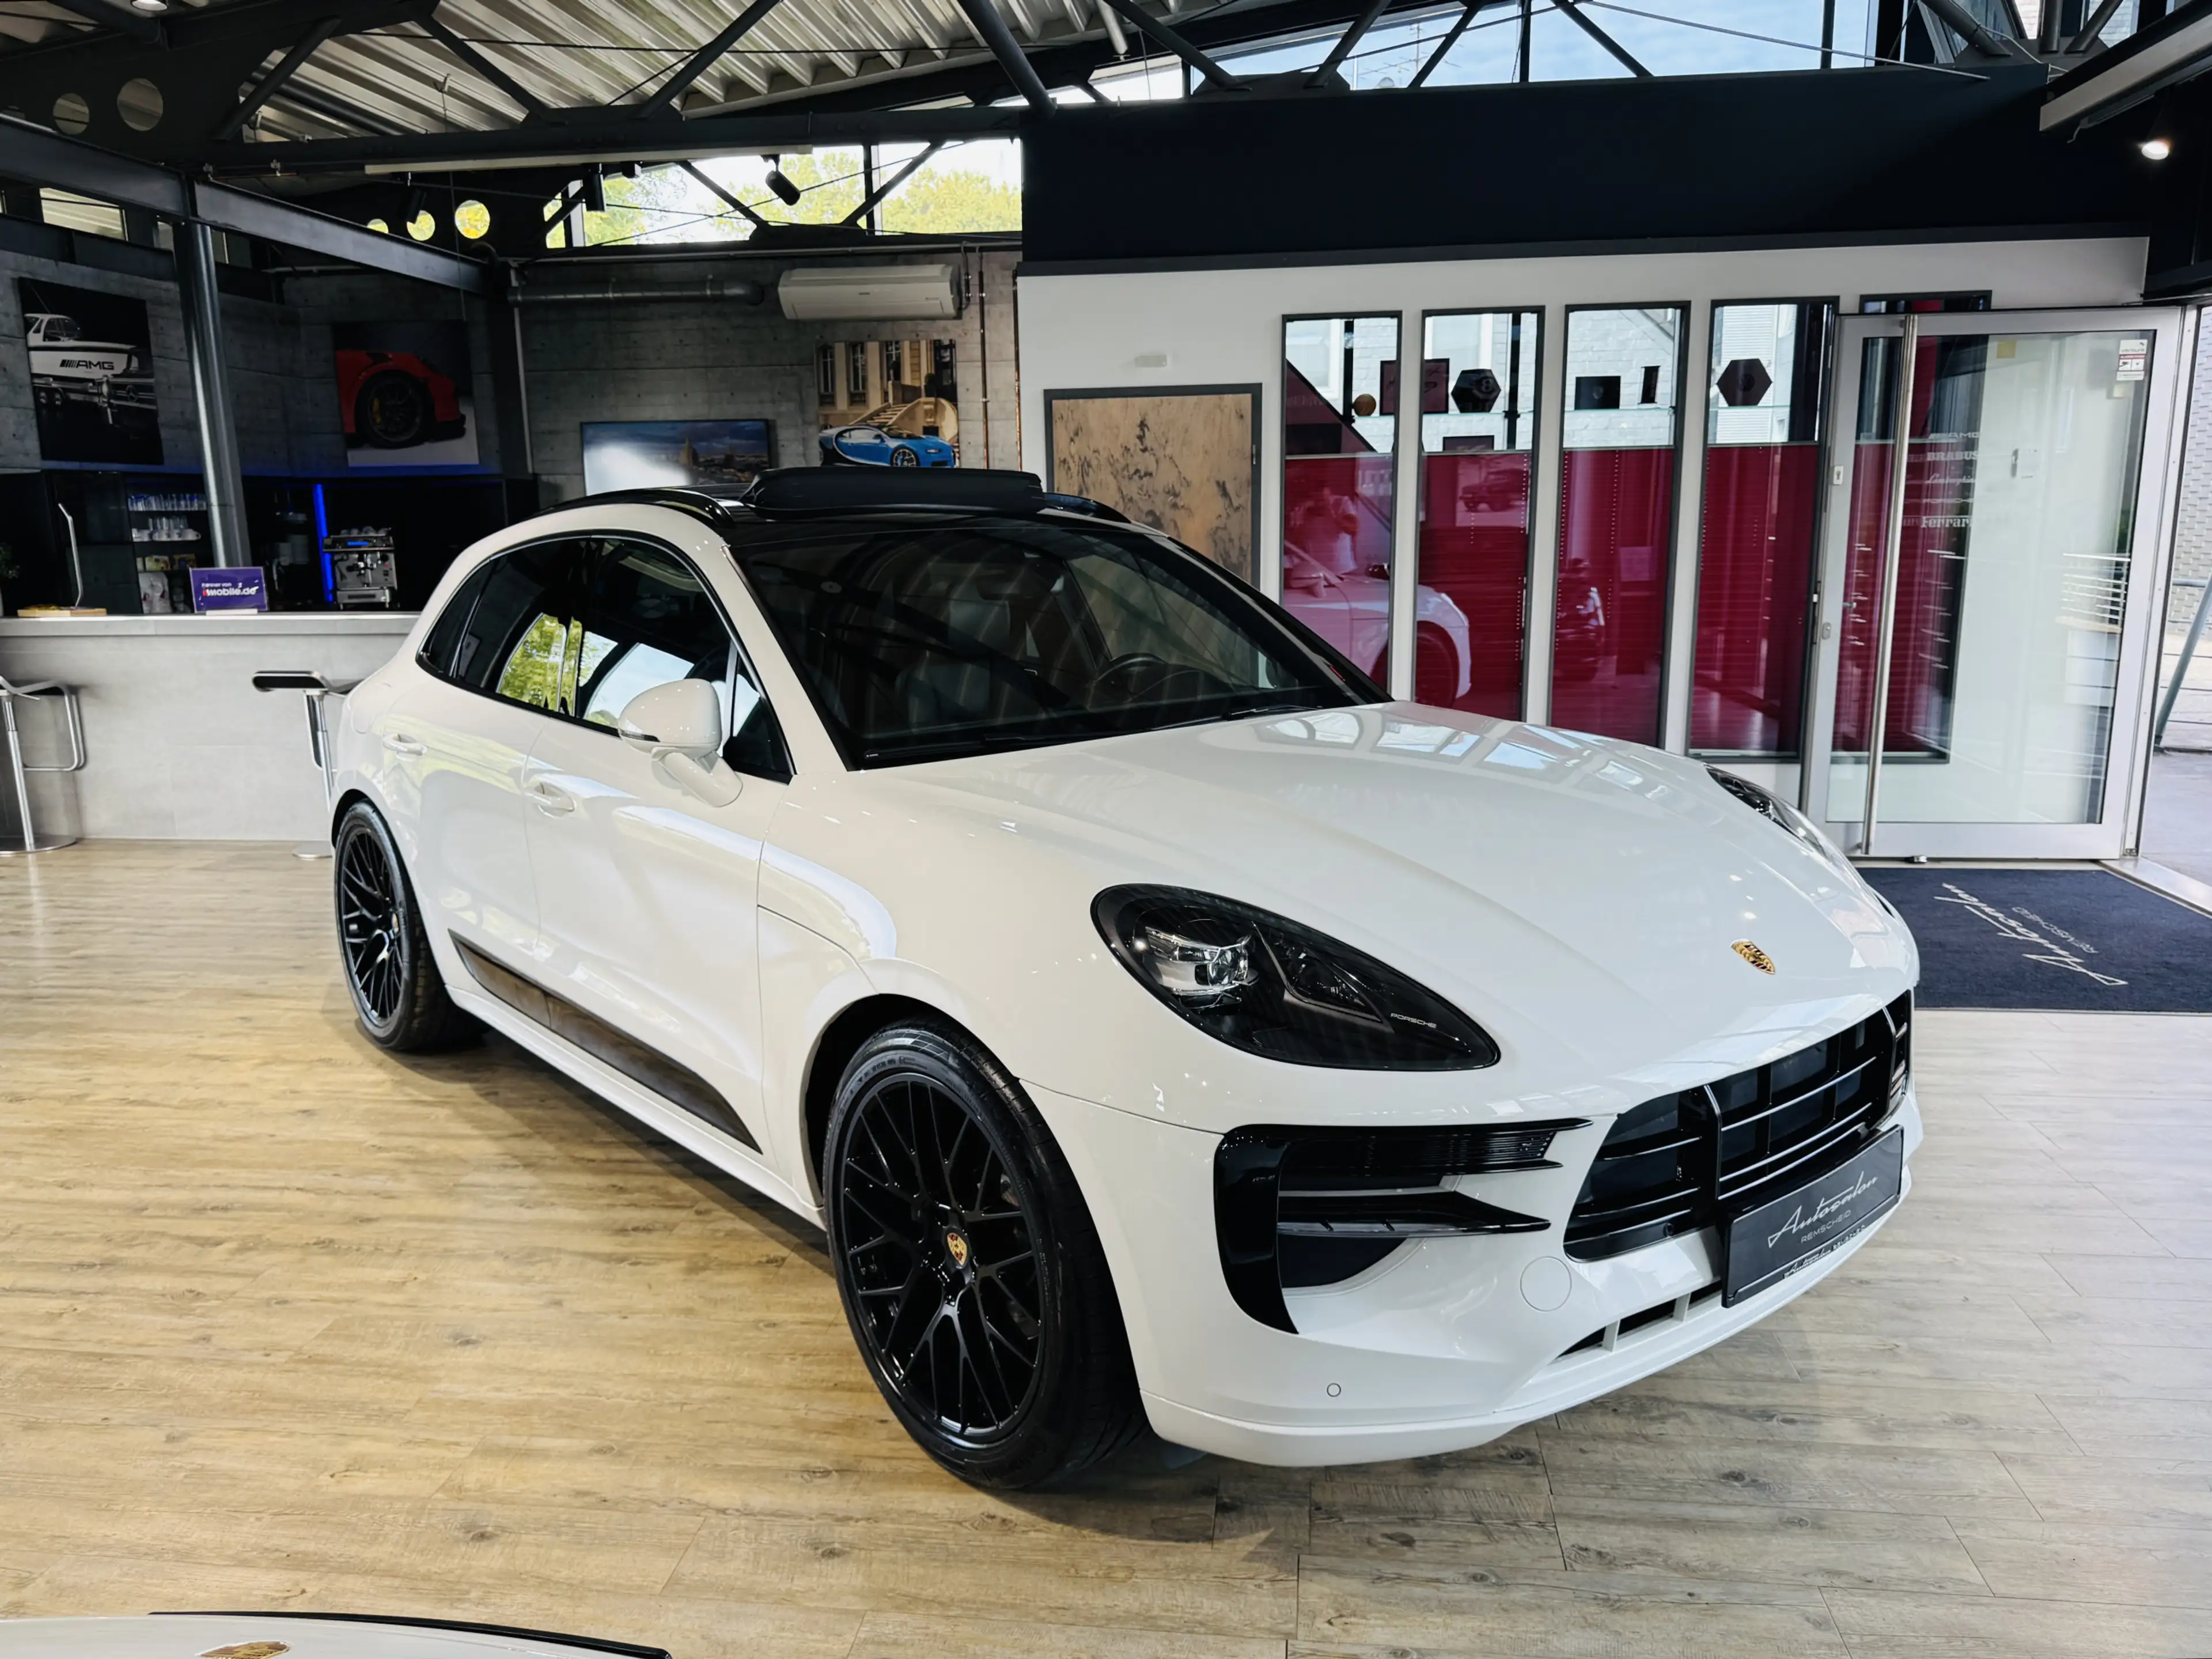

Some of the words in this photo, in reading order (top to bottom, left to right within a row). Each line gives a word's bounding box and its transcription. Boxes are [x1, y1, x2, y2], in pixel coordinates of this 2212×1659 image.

[76, 359, 114, 370] AMG
[1927, 451, 1979, 461] BRABUS
[1391, 1013, 1437, 1029] PORSCHE
